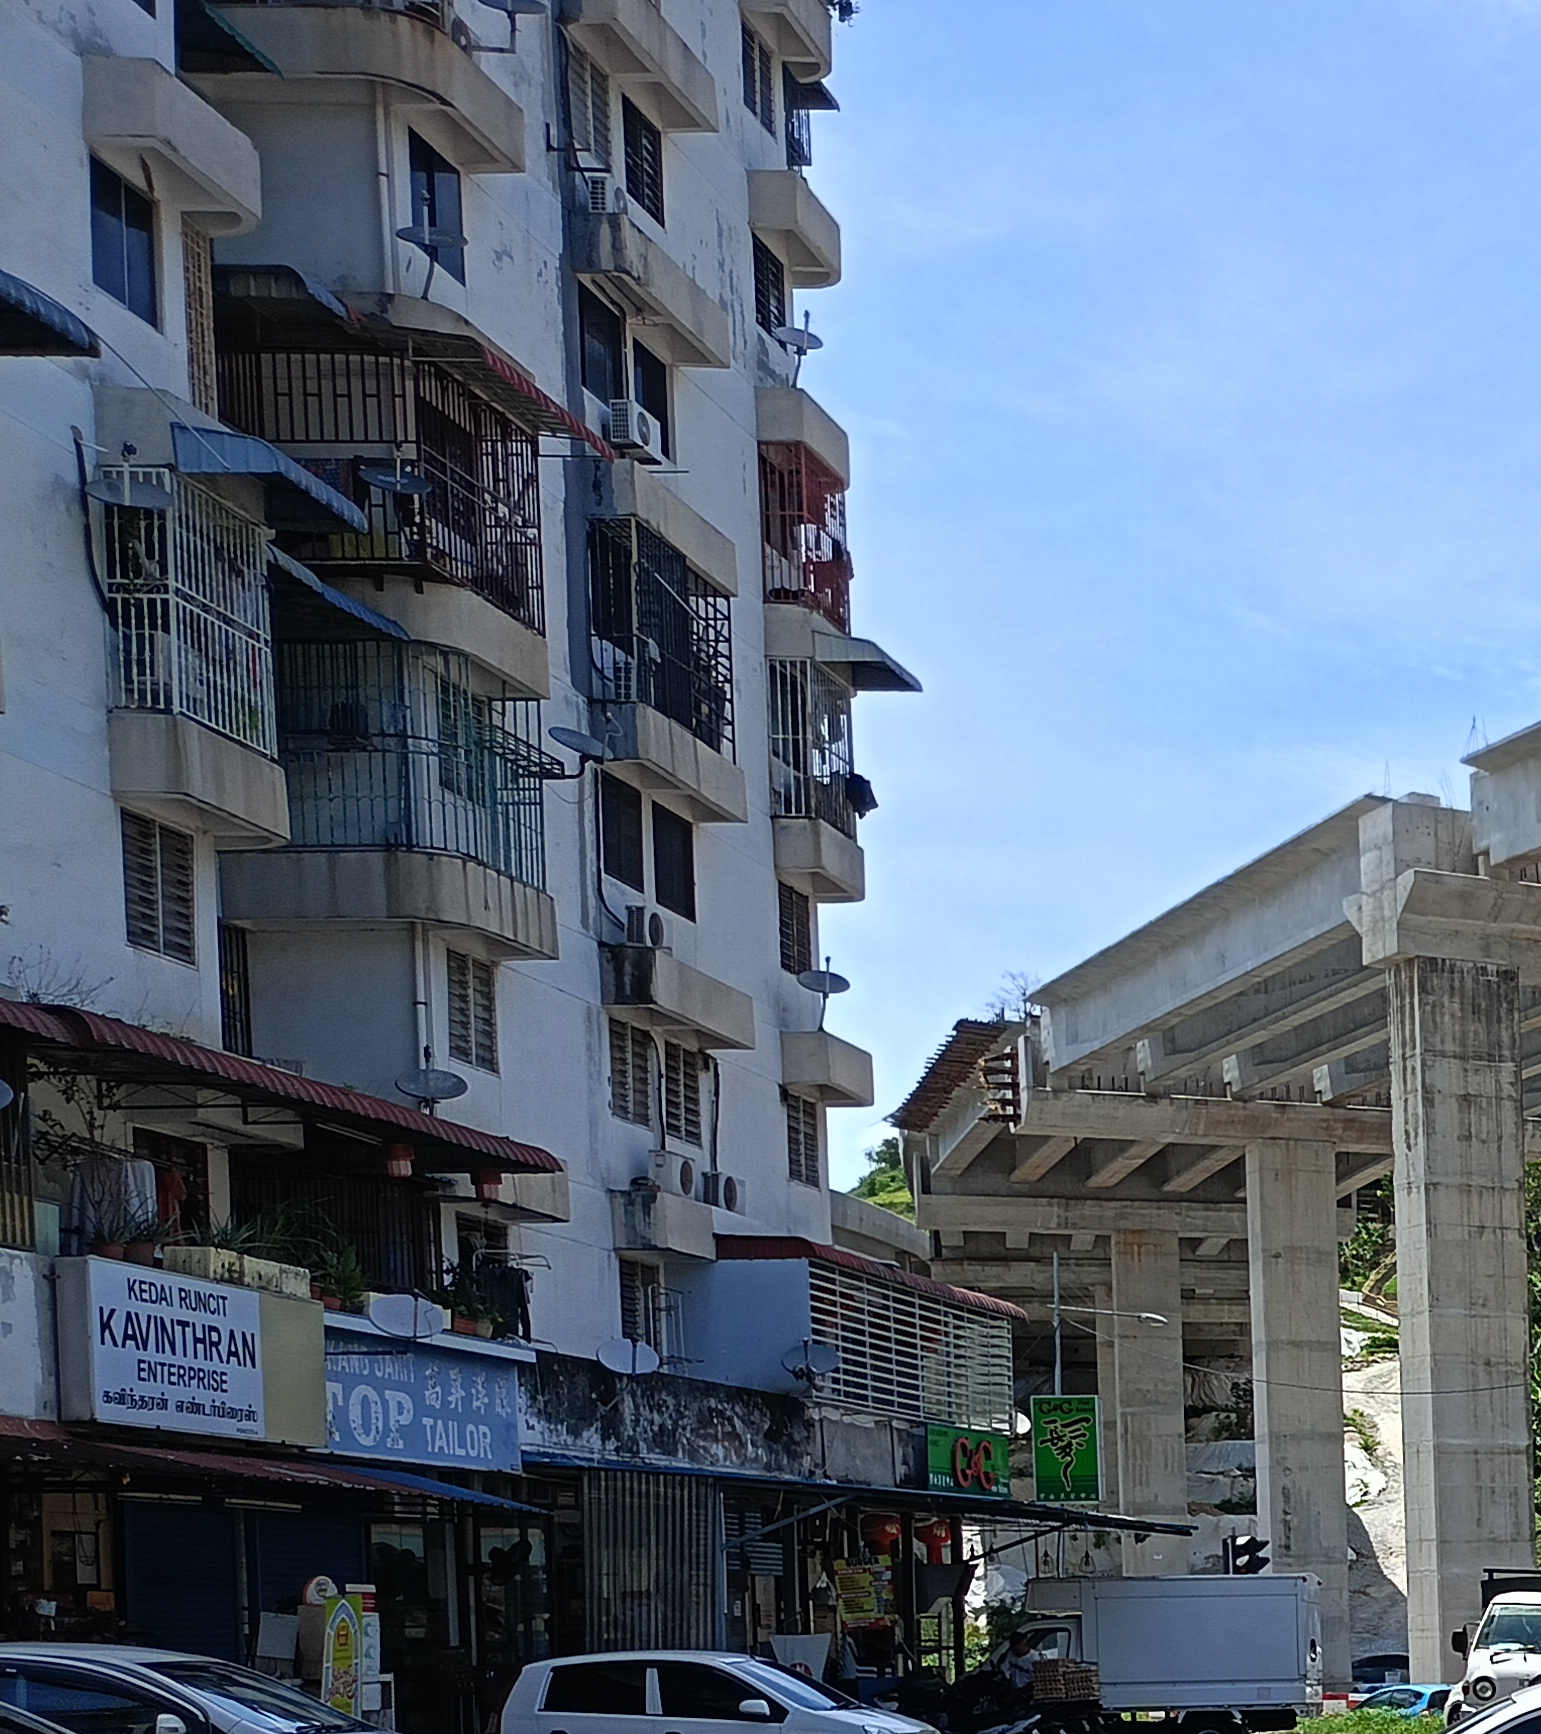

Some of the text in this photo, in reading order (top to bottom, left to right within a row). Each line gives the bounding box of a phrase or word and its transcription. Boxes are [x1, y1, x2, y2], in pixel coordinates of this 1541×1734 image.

[127, 1277, 228, 1317] KEDAI RUNCIT
[98, 1305, 257, 1369] KAVINTHRAN
[137, 1358, 228, 1393] ENTERPRISE
[326, 1381, 414, 1449] TOP
[422, 1417, 493, 1460] TAILOR
